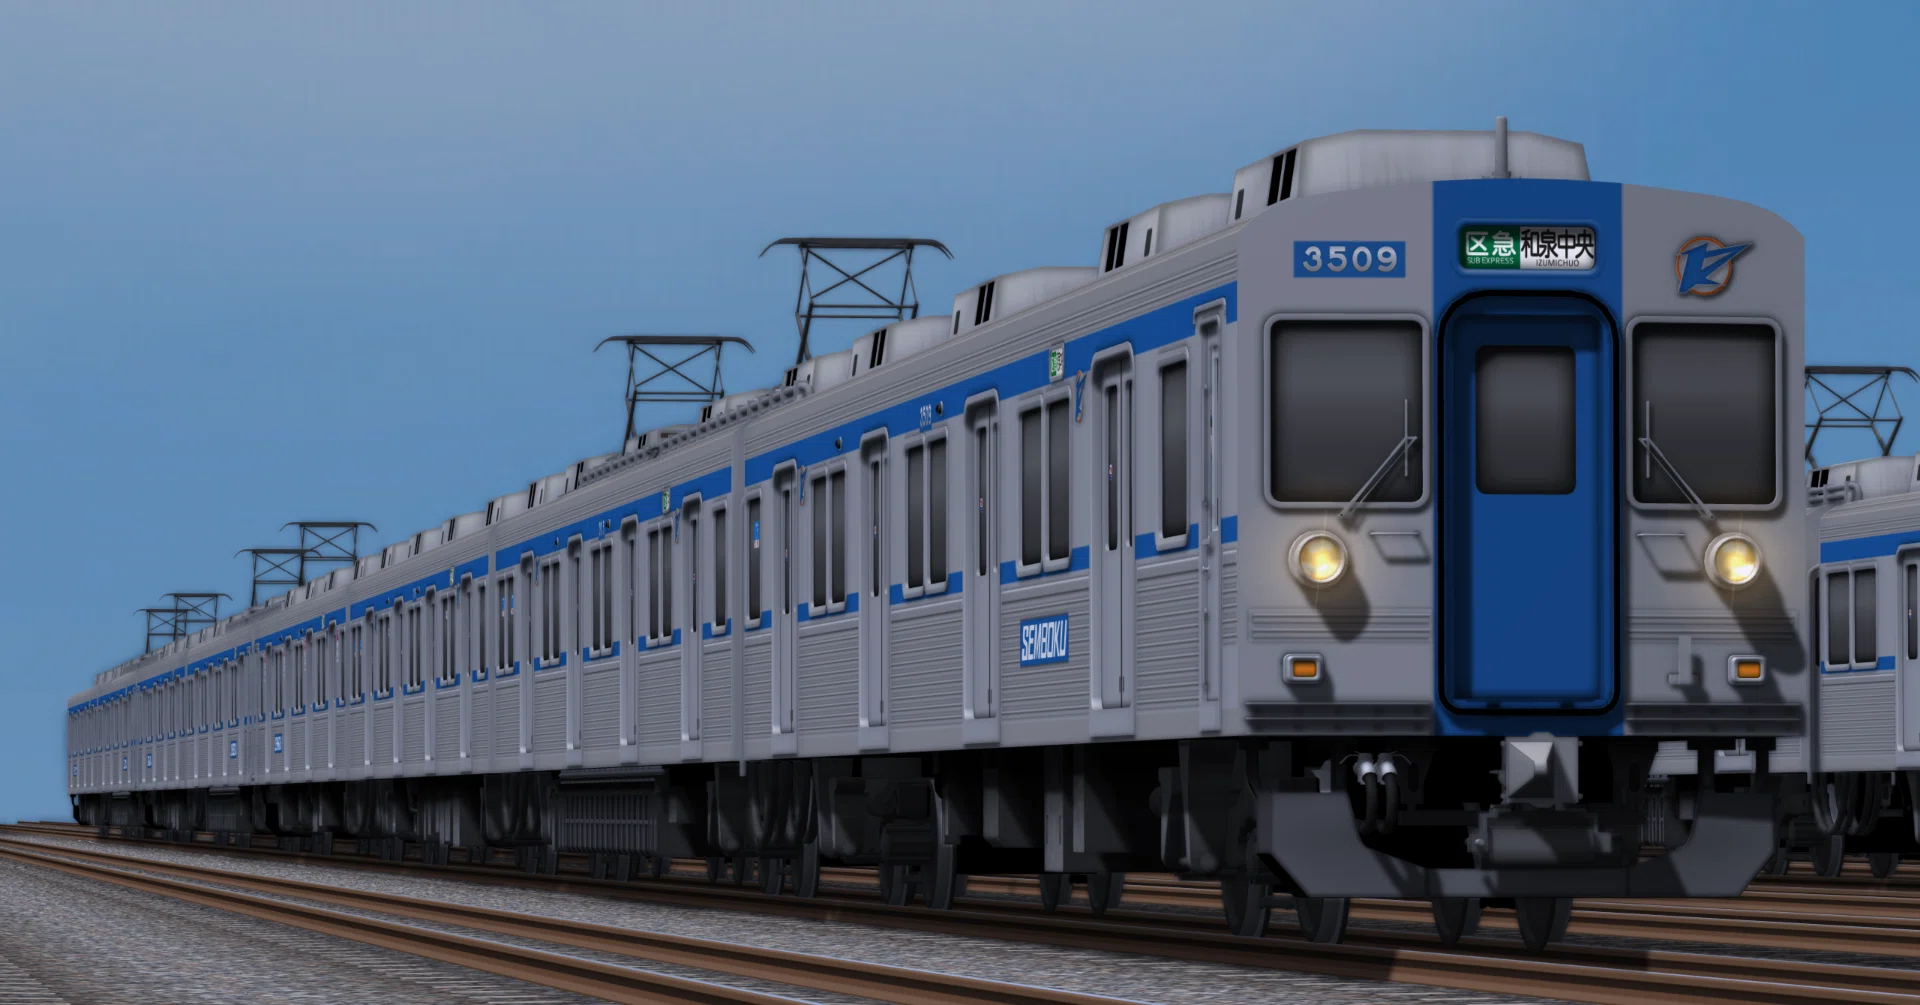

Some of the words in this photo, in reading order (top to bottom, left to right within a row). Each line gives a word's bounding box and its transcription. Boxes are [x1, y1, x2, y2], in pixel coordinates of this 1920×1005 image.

[1465, 230, 1516, 257] 区急
[1520, 228, 1594, 259] 和泉中央
[1302, 245, 1398, 272] 3509
[1466, 257, 1481, 265] SUB
[1482, 257, 1514, 265] EXPRESS
[1536, 259, 1580, 267] IZUMICHUO
[1021, 619, 1068, 661] SEMBOKU
